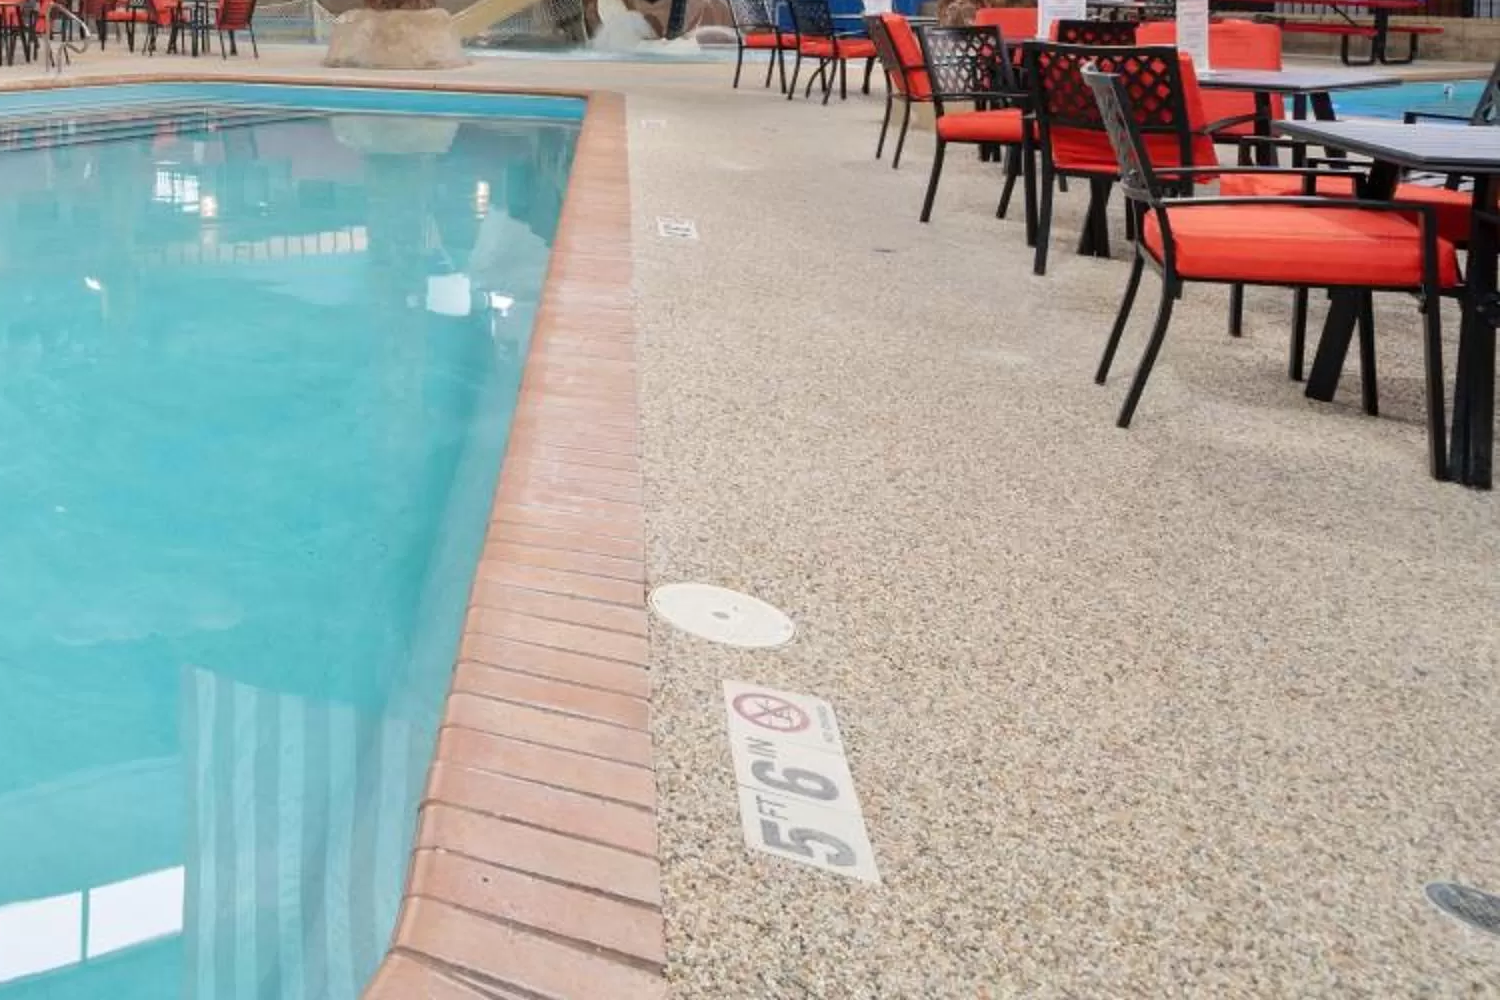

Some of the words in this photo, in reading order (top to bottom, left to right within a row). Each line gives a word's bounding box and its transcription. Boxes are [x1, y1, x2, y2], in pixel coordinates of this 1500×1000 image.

[744, 735, 777, 758] IN
[751, 760, 840, 801] 6
[755, 794, 788, 820] FT
[760, 819, 857, 867] 5
